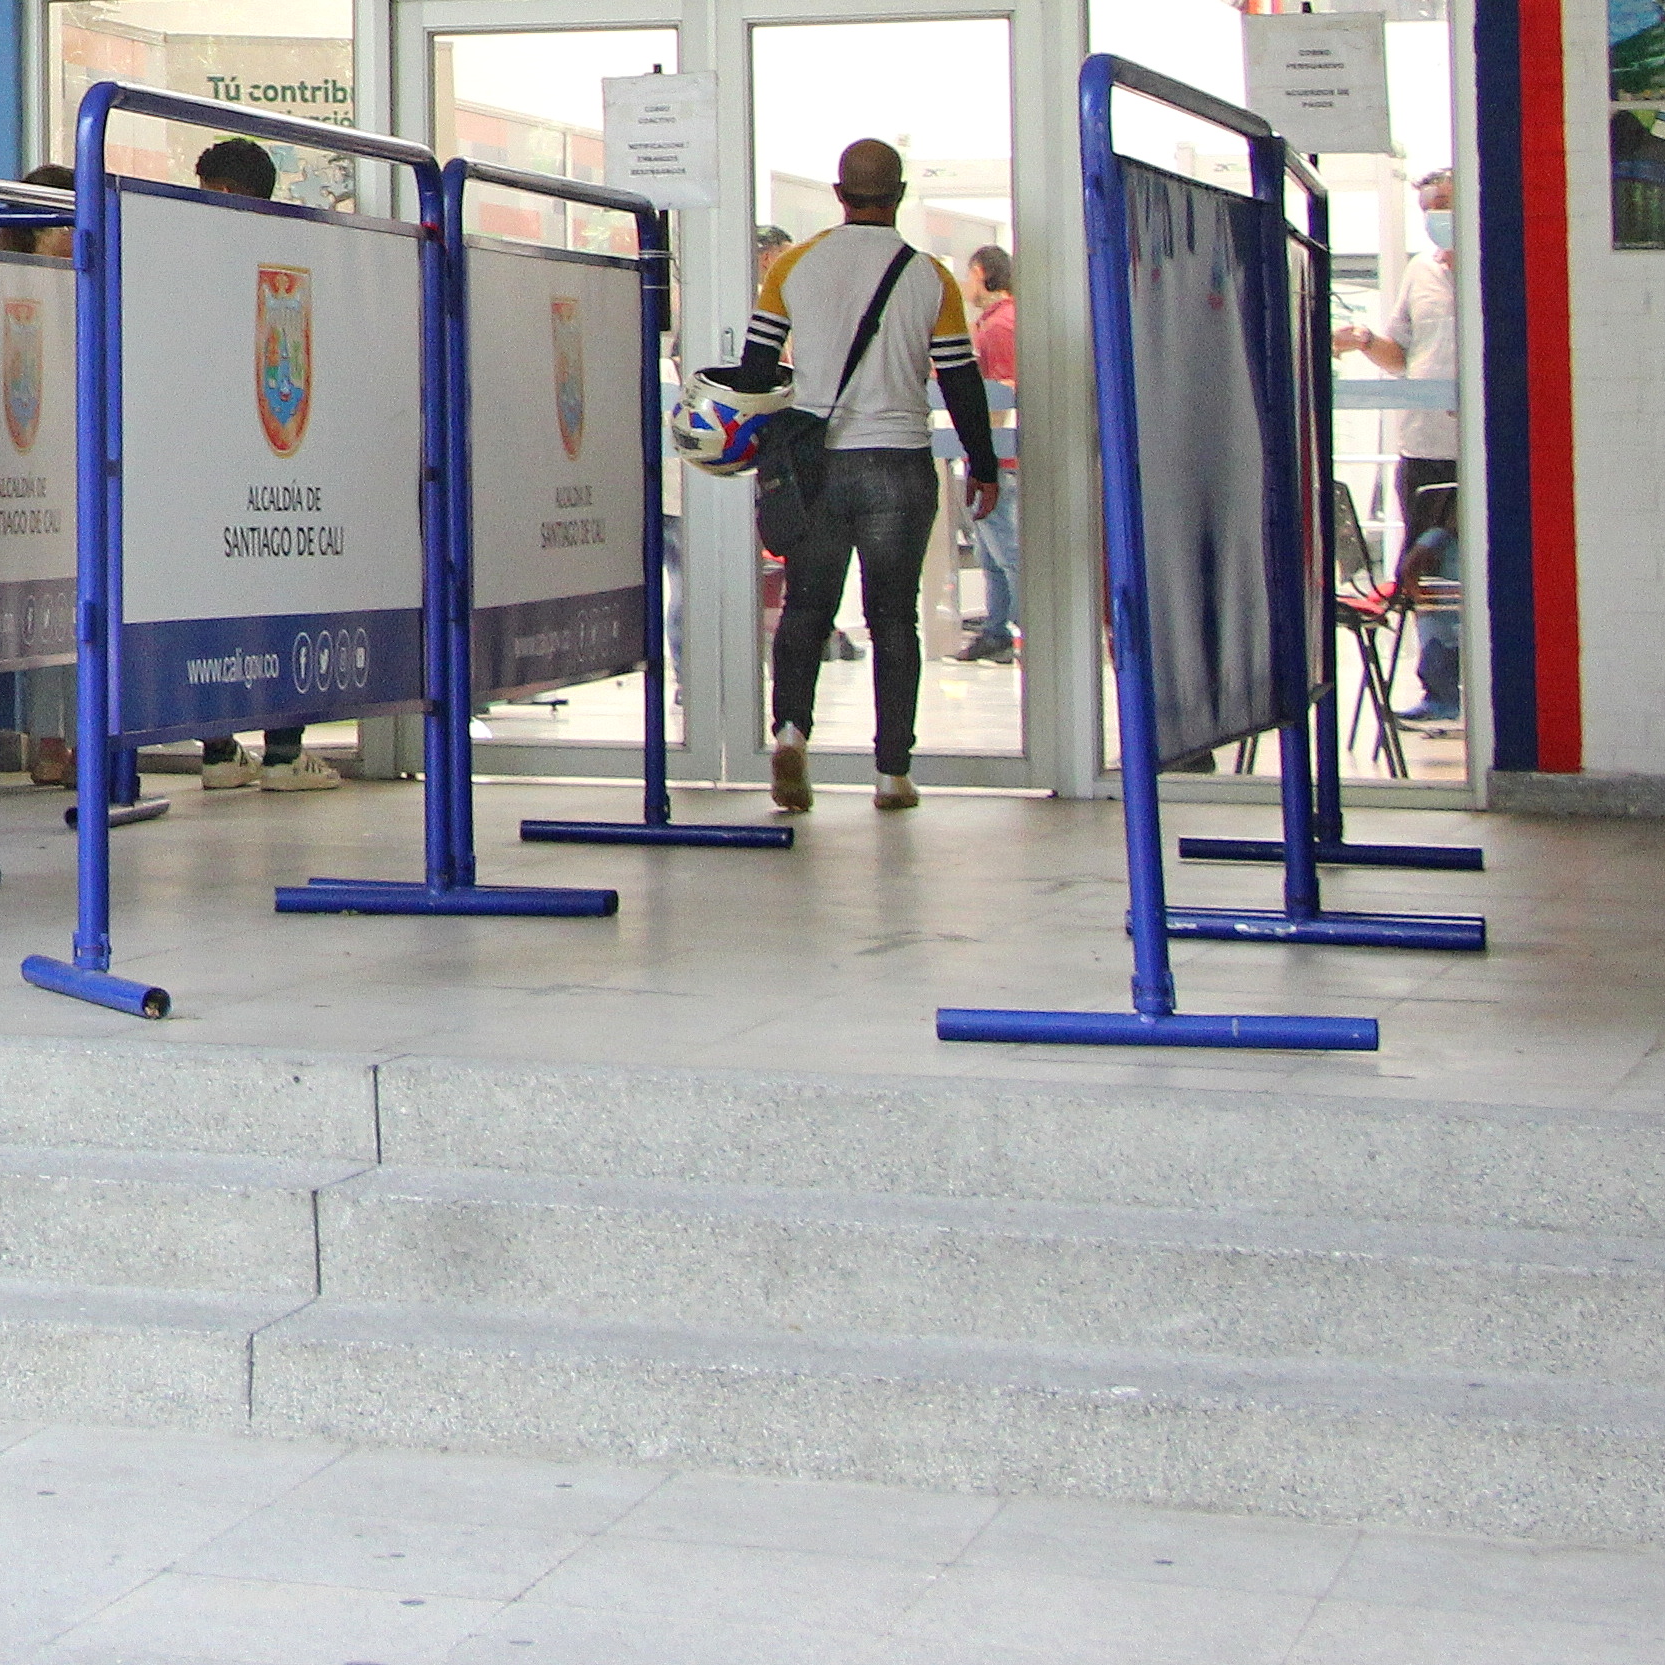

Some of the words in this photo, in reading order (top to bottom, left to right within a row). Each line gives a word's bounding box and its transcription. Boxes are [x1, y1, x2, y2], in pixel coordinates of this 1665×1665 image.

[207, 76, 241, 101] Tú
[248, 78, 355, 103] contrib
[247, 479, 302, 511] ALCALDÍA
[307, 486, 322, 511] DE
[223, 525, 292, 557] SANTIAGO
[296, 526, 315, 556] DE
[318, 525, 344, 556] CALI
